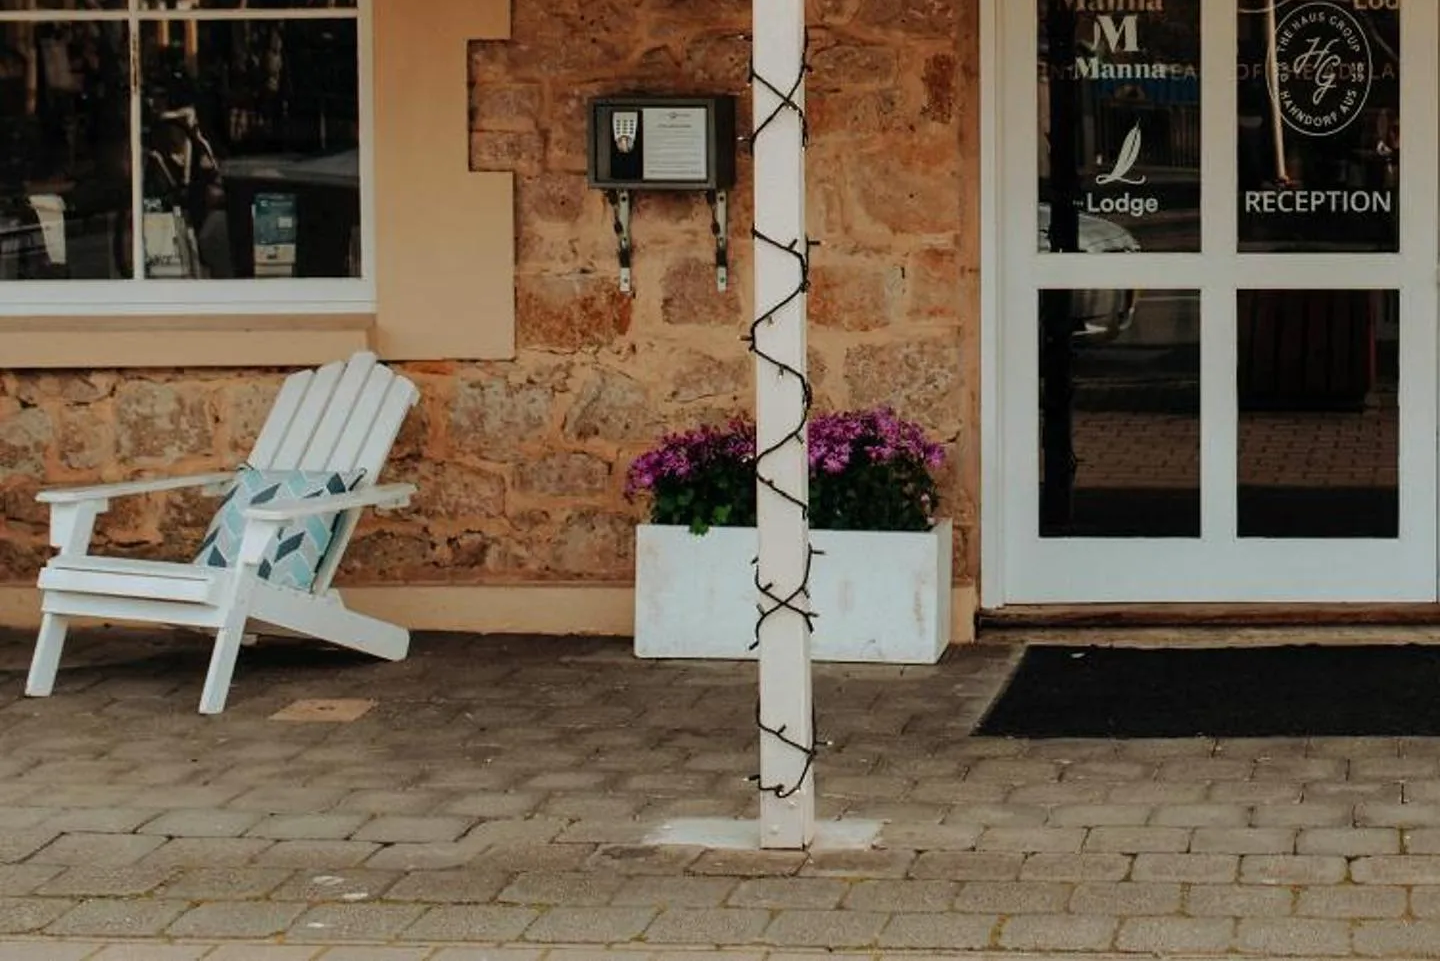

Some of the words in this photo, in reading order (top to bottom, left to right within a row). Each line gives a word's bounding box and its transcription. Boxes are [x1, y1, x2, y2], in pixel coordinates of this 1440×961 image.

[1292, 12, 1326, 30] HAUS
[1074, 56, 1167, 80] Manna
[1280, 90, 1338, 127] HAHNDORF
[1087, 192, 1159, 217] Lodge
[1245, 190, 1392, 213] RECEPTION
